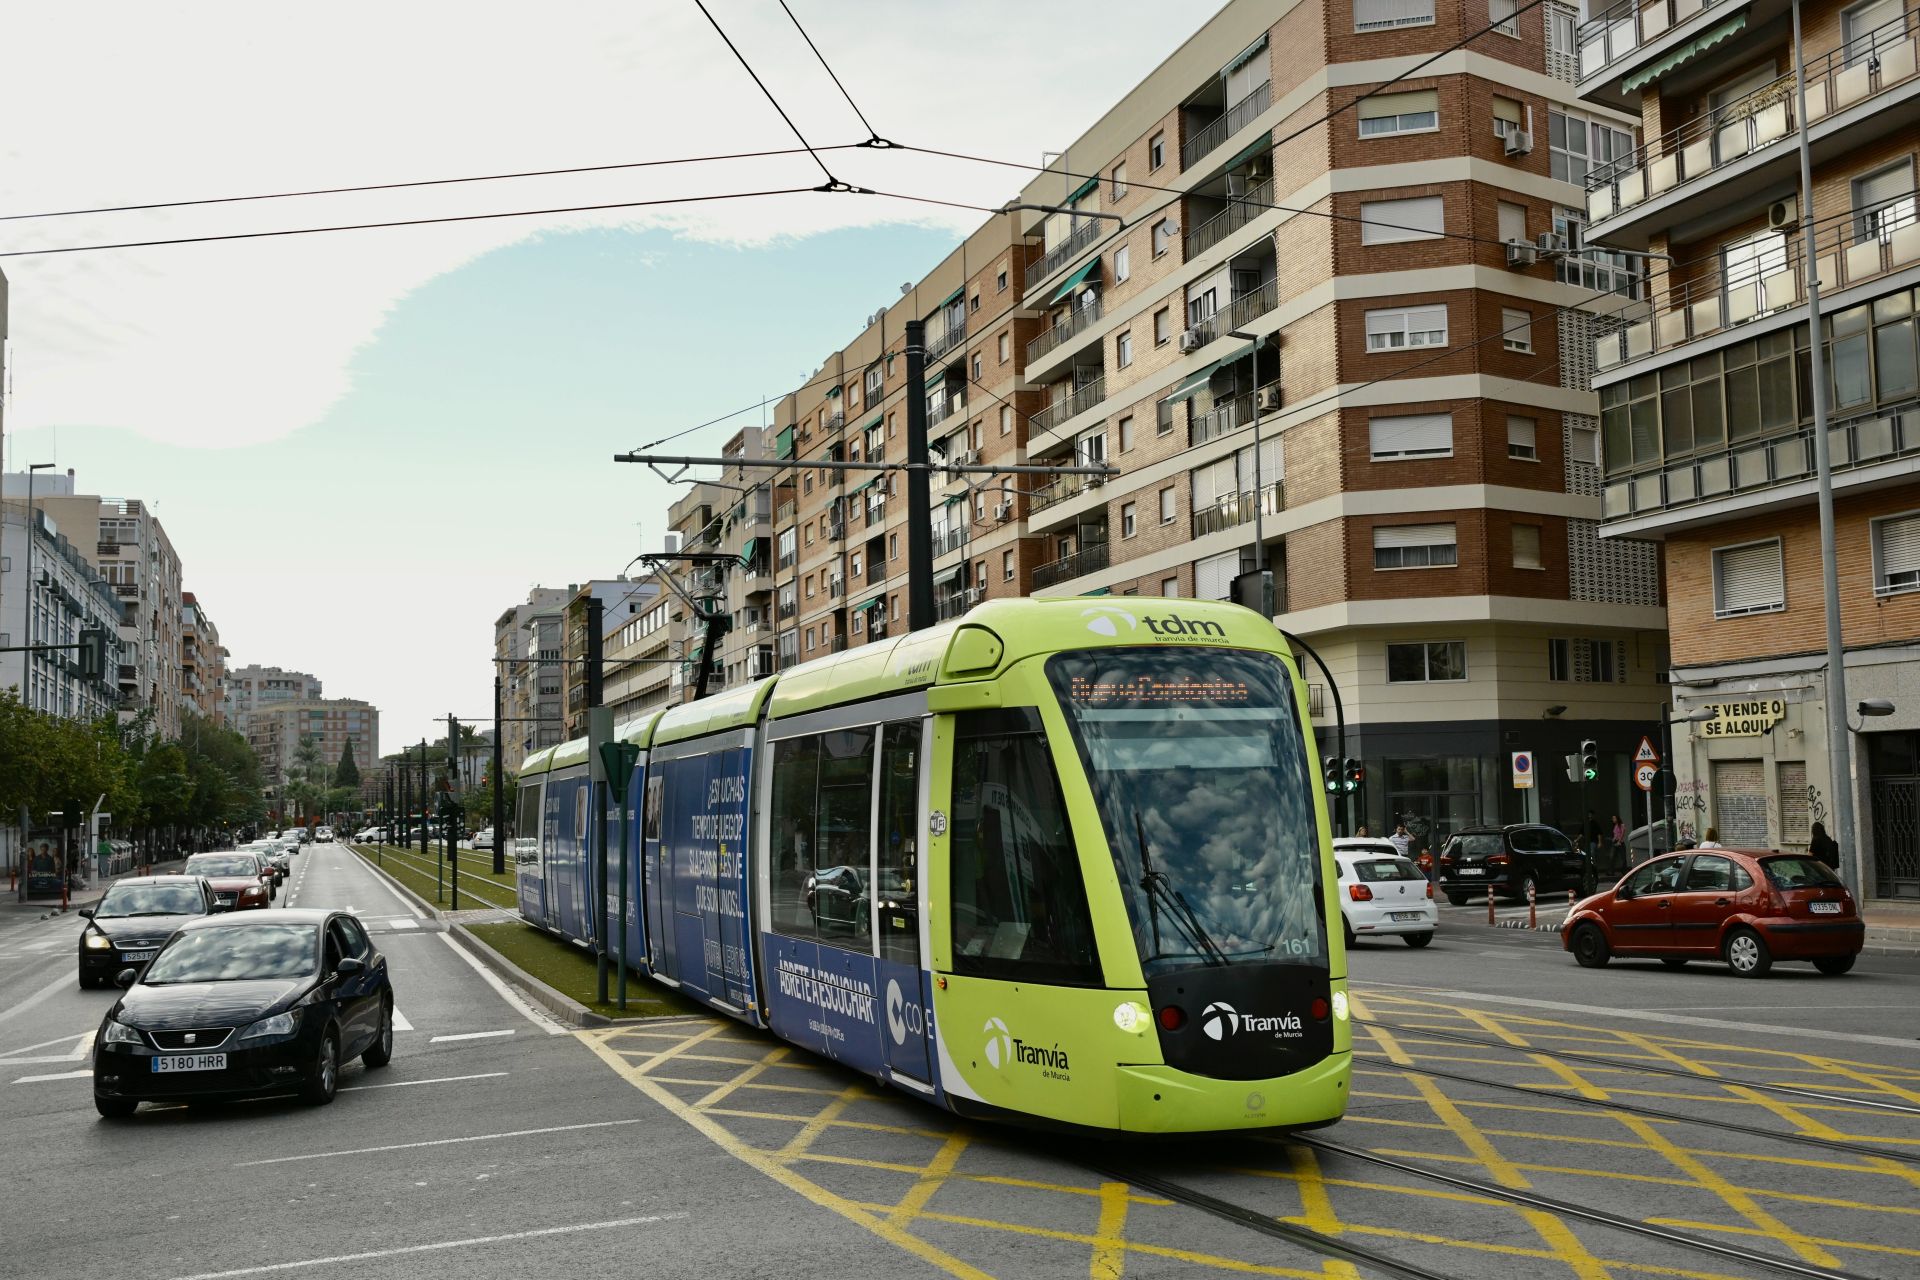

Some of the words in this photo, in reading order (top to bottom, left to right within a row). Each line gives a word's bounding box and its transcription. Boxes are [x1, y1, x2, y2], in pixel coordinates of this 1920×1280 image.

[1142, 613, 1226, 637] tdm
[1200, 637, 1230, 645] murcia
[1723, 701, 1768, 717] VENDE
[1771, 700, 1781, 714] O
[1705, 722, 1722, 735] SE
[1283, 938, 1311, 955] 161
[128, 952, 146, 961] 5253
[819, 970, 875, 1025] ESCUCHAR
[1241, 1011, 1302, 1032] Tranvía
[160, 1057, 194, 1070] 5180
[198, 1055, 224, 1068] HRR
[1013, 1039, 1070, 1070] Tranvía
[1042, 1070, 1050, 1078] de
[1050, 1072, 1071, 1082] Murcia
